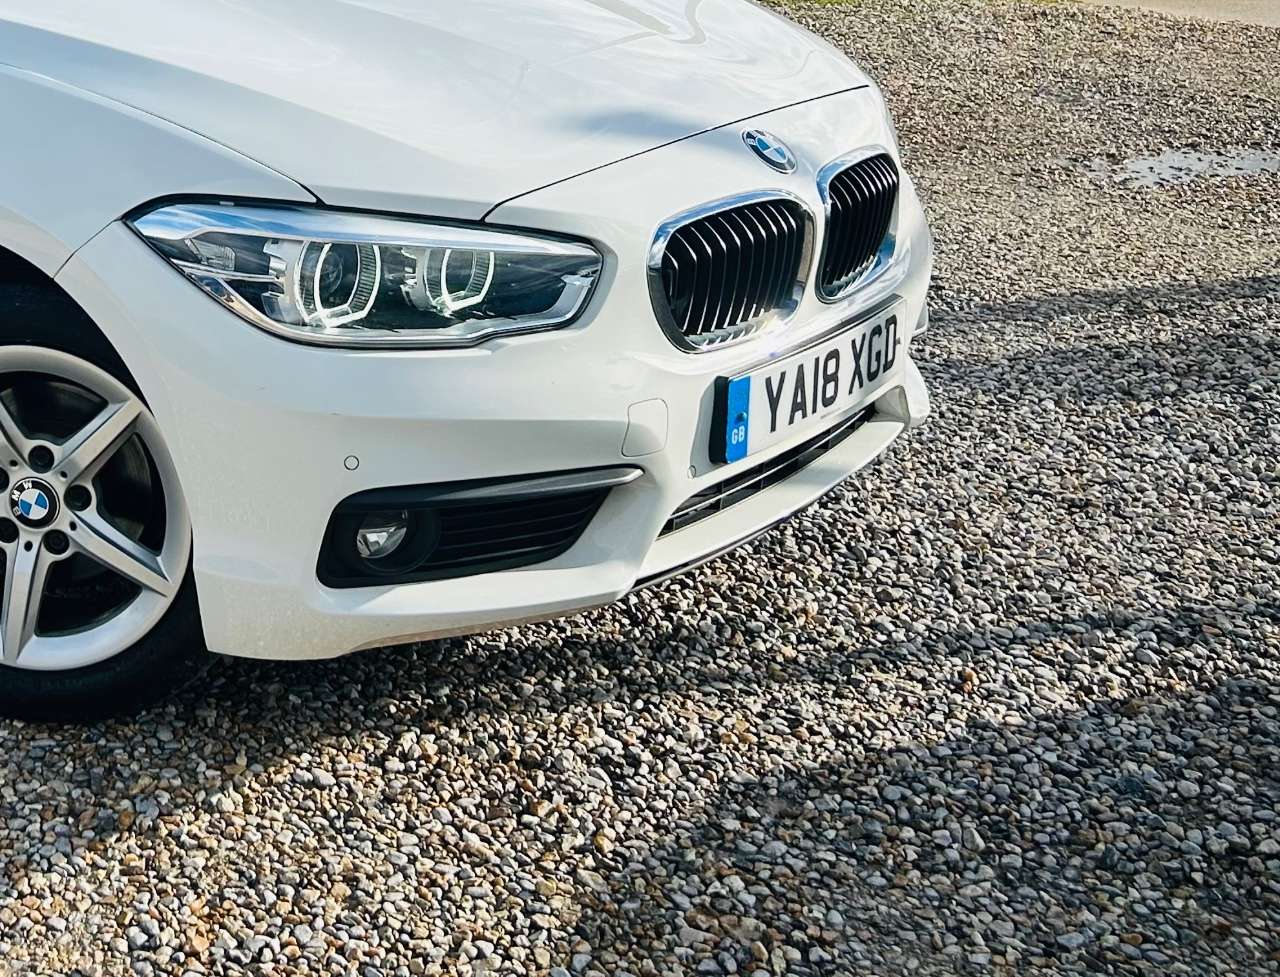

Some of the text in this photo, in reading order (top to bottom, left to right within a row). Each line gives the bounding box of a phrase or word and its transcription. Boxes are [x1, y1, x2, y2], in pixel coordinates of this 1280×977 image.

[765, 314, 898, 434] YA18 XGD
[731, 426, 746, 445] GB
